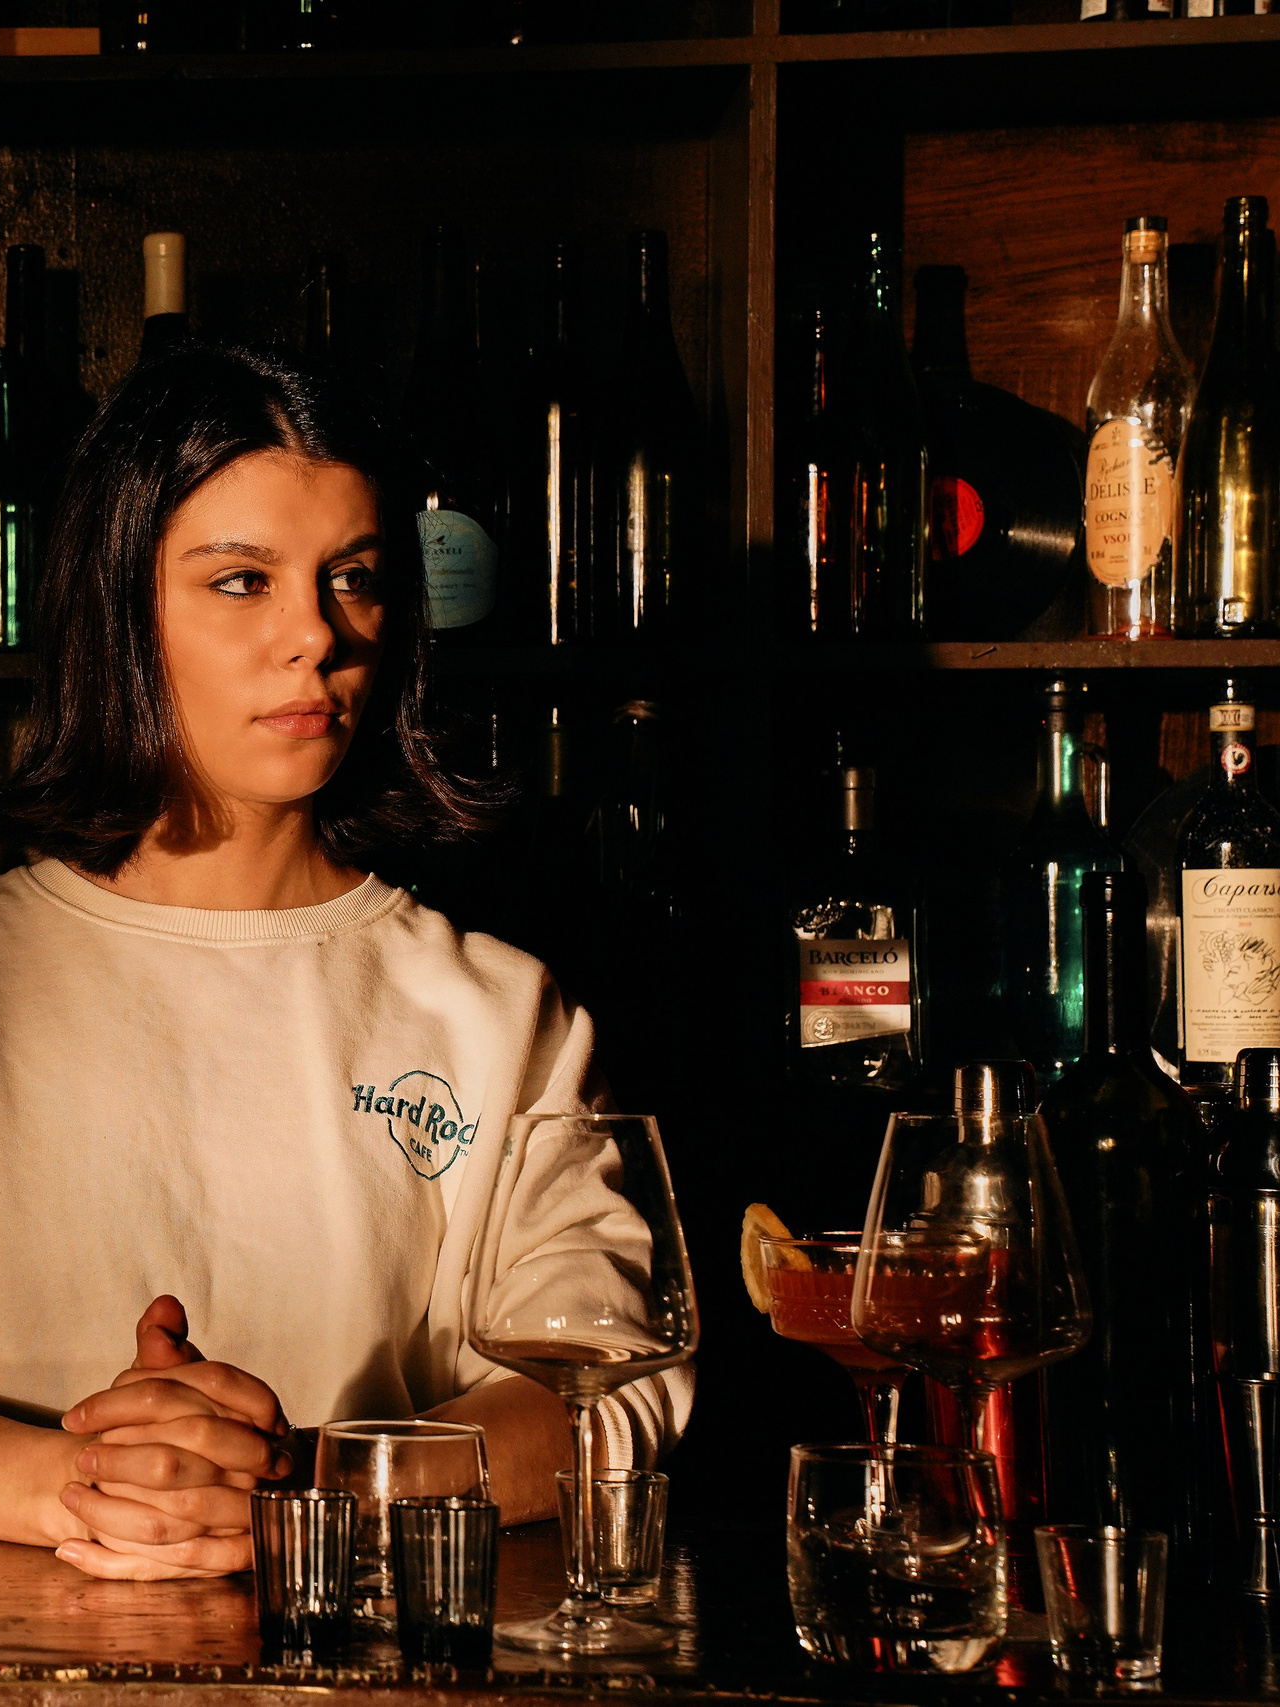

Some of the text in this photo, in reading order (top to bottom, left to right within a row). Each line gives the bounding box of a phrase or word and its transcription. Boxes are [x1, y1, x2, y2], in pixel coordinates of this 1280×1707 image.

[1090, 476, 1156, 501] DELISE
[809, 946, 899, 967] BARCELÓ
[352, 1084, 426, 1128] Hard
[409, 1137, 433, 1163] CAFE
